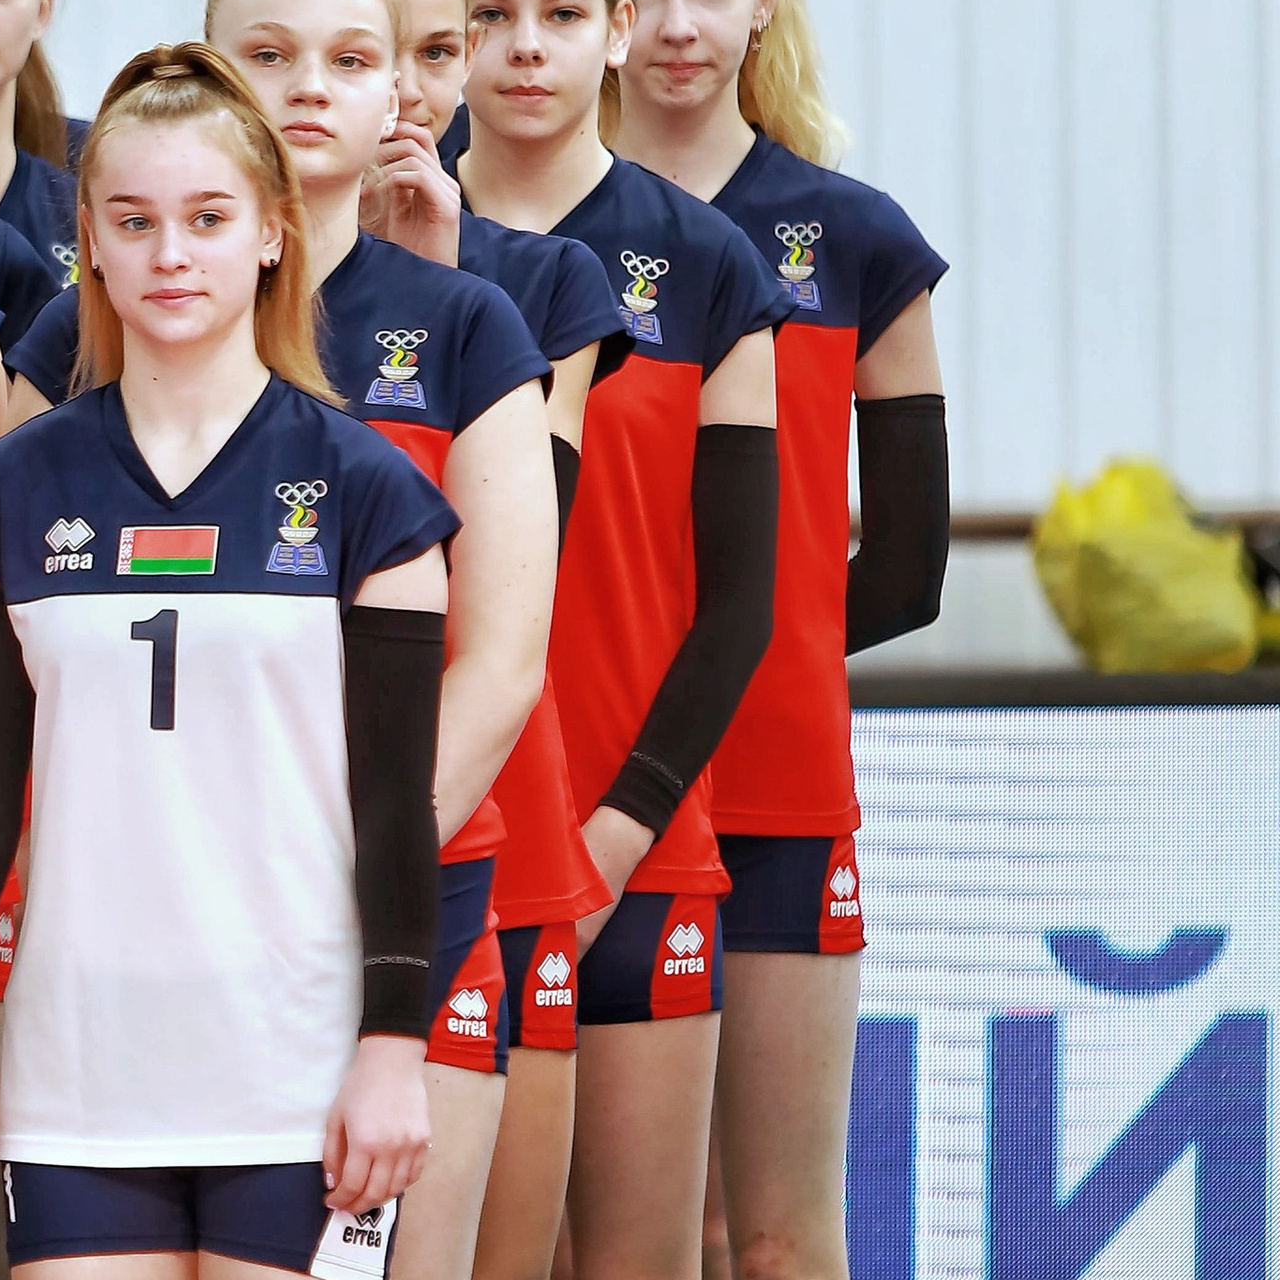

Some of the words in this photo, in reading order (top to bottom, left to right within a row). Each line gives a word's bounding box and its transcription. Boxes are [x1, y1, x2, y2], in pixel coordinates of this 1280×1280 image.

[45, 553, 93, 574] errea
[131, 609, 179, 731] 1
[829, 899, 861, 918] errea
[663, 957, 705, 975] errea
[535, 989, 573, 1007] errea
[447, 1018, 487, 1038] errea
[342, 1226, 382, 1248] errea
